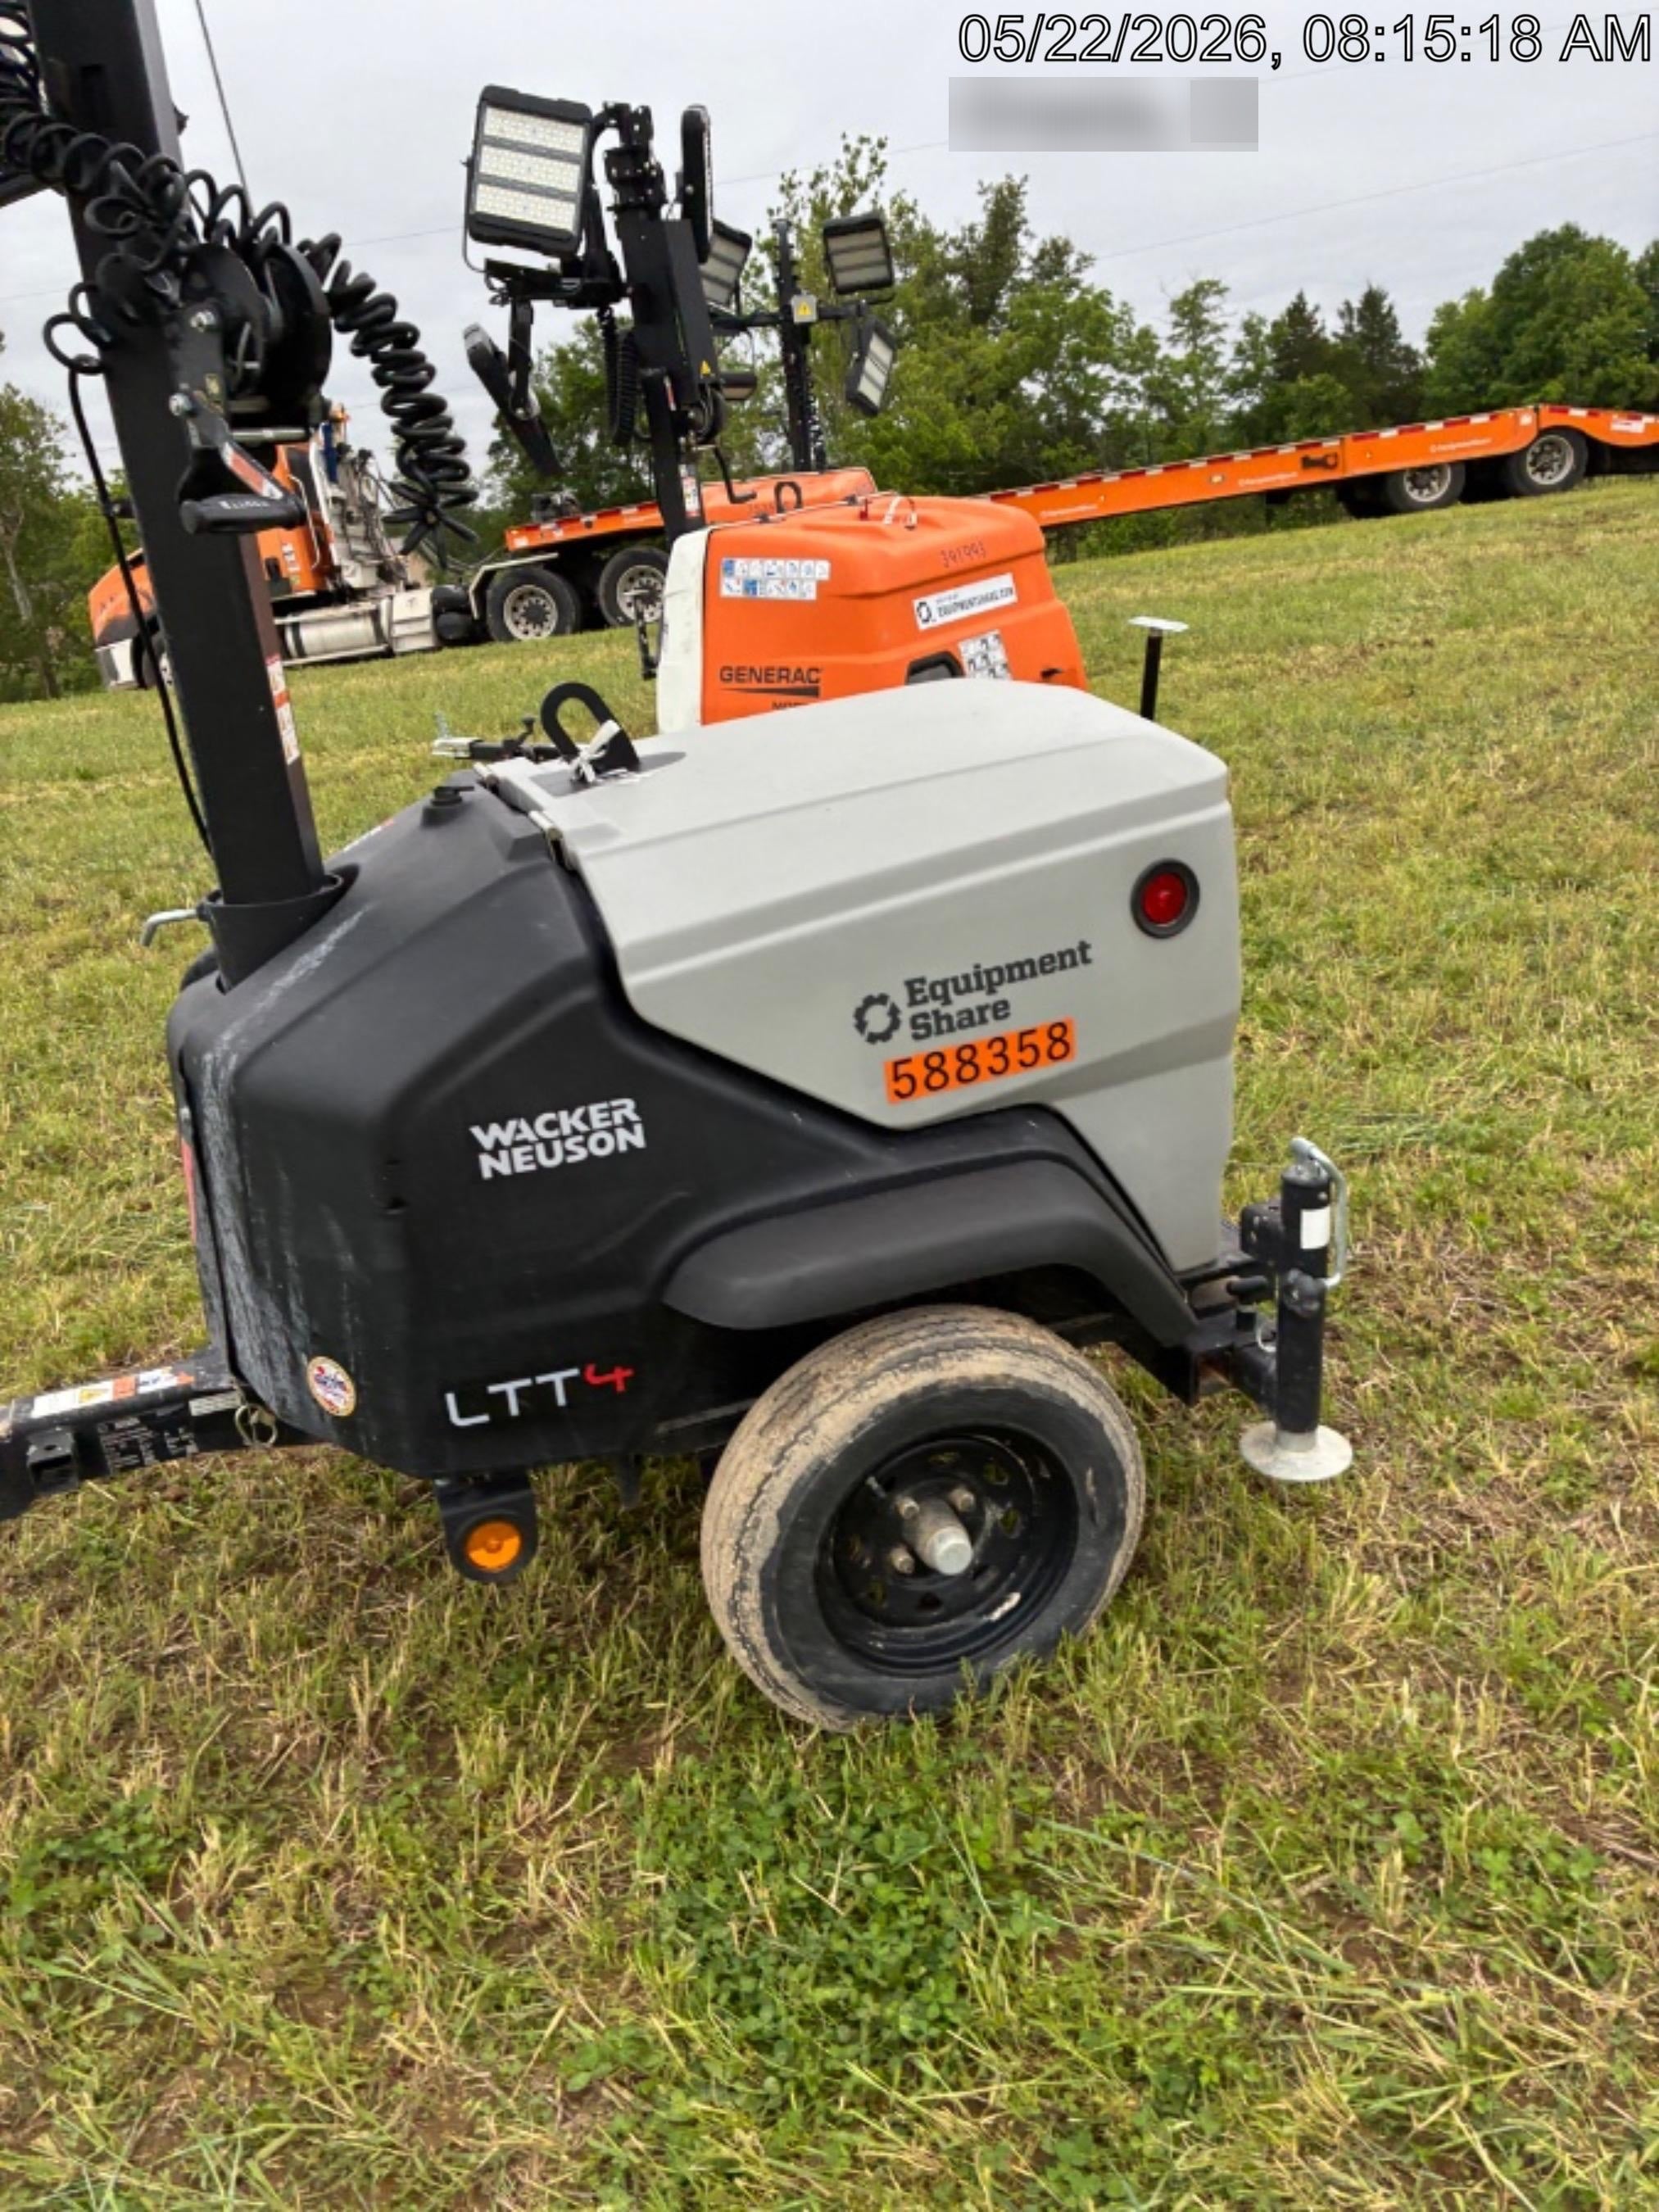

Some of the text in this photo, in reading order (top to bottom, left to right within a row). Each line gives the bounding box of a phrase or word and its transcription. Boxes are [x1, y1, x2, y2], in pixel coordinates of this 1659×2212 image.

[719, 665, 821, 684] GENERAC
[904, 940, 1093, 1008] Equipment
[909, 998, 1012, 1042] Share
[891, 1022, 1072, 1099] 588358
[469, 1097, 641, 1151] WACKER
[478, 1122, 647, 1180] NEUSON
[445, 1363, 635, 1427] LTT4
